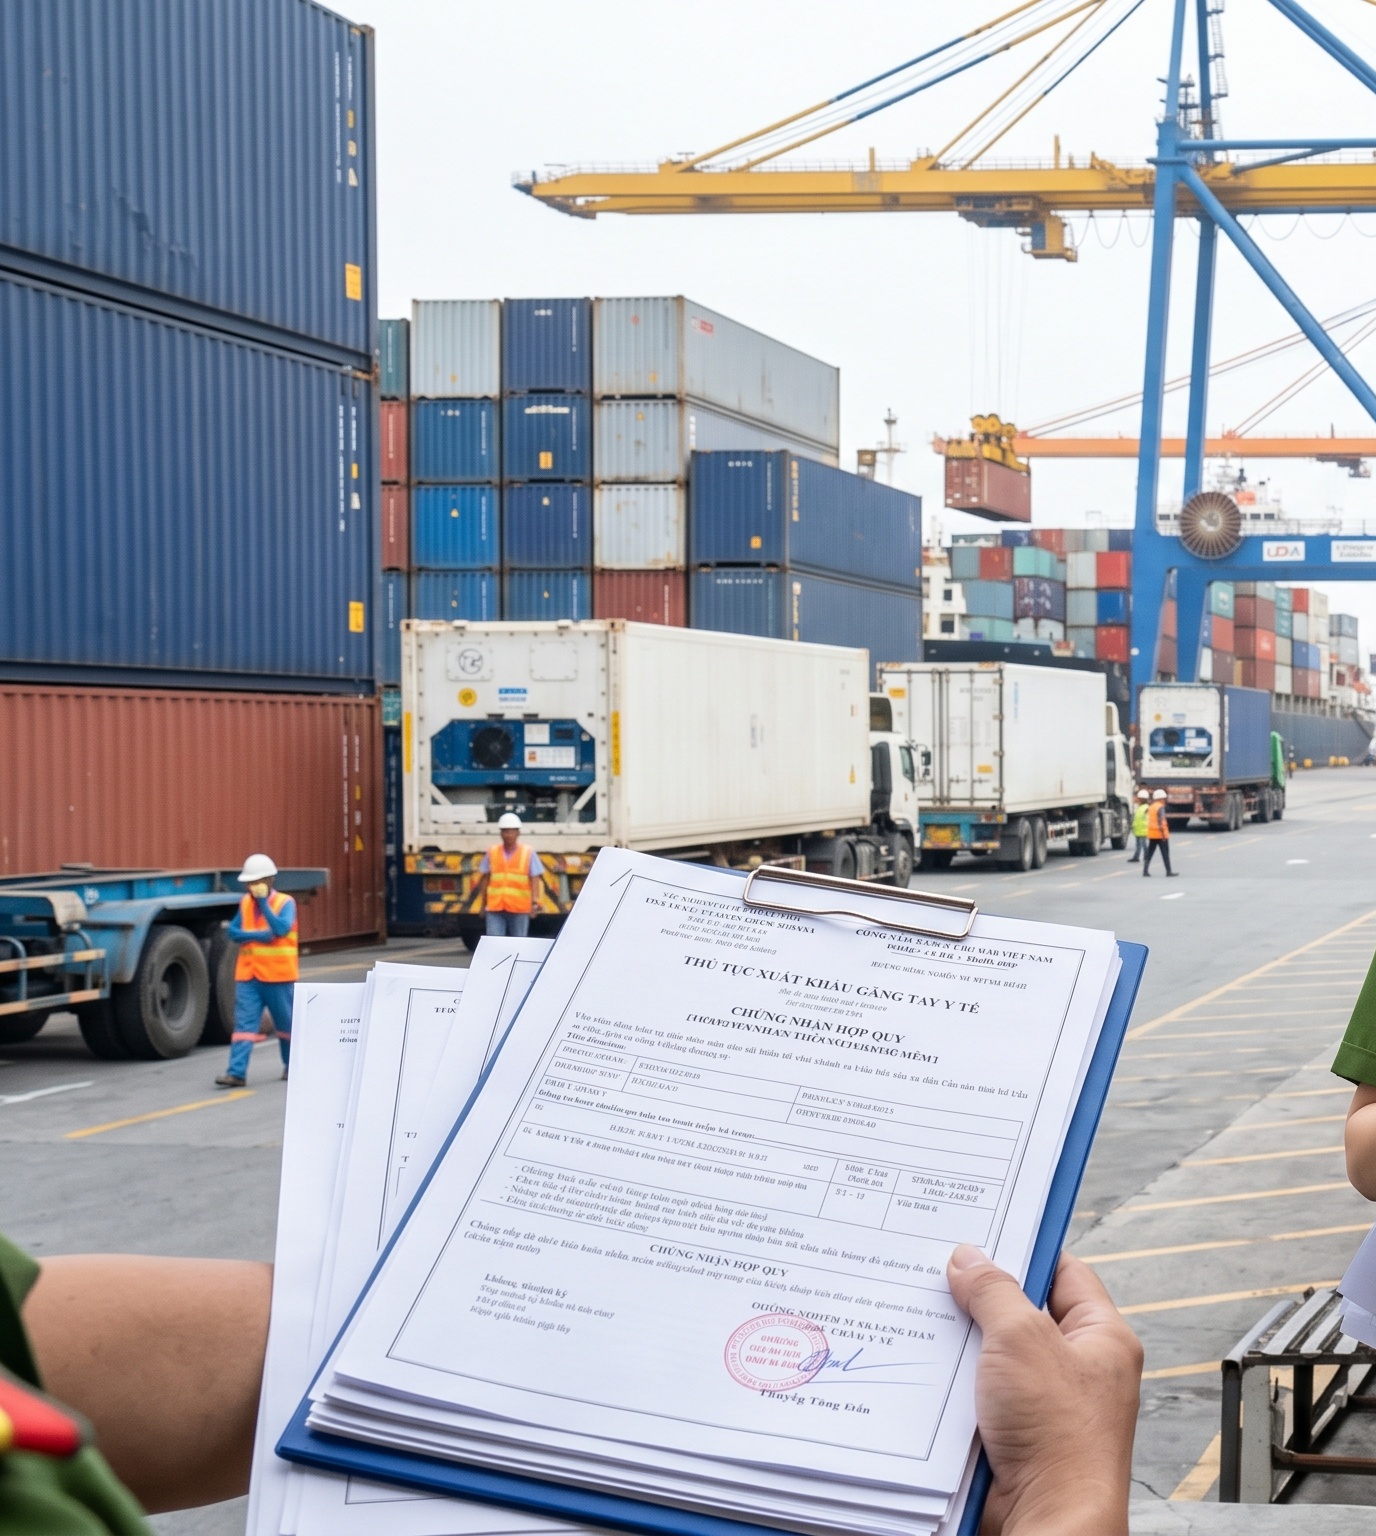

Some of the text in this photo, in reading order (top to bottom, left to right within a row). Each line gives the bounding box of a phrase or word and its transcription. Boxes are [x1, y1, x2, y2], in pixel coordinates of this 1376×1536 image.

[907, 993, 941, 1008] TAY
[944, 1000, 957, 1010] Y
[871, 1030, 906, 1044] QUY
